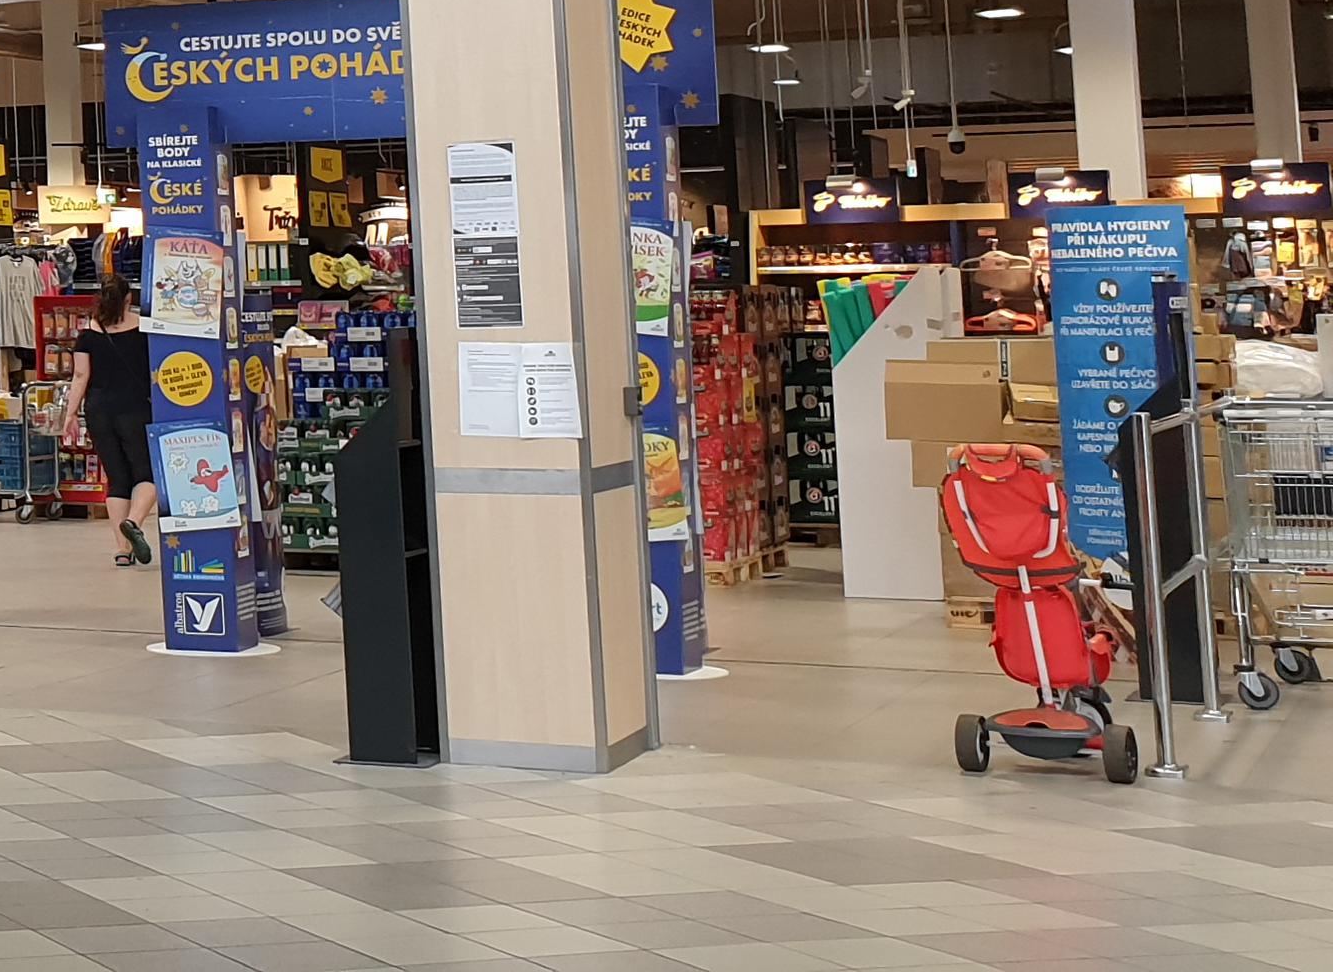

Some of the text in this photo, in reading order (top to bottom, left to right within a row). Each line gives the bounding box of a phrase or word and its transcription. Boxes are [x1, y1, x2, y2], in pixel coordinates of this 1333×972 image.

[621, 8, 651, 23] EDICE
[618, 19, 662, 38] ESKÝCH
[179, 21, 402, 52] CESTUJTE SPOLU DO SVĚ
[618, 31, 655, 48] HÁDEK
[121, 37, 405, 103] ČESKÝCH POHÁD
[148, 133, 198, 147] SBÍREJTE
[625, 140, 651, 151] SICKÉ
[157, 147, 190, 158] BODY
[146, 157, 202, 169] NA KLASICKÉ
[147, 171, 203, 204] ČESKÉ
[152, 204, 204, 215] POHÁDKY
[1107, 220, 1171, 231] HYGIENY
[632, 232, 662, 245] NKA
[1067, 232, 1147, 246] PŘI NÁKUPU
[169, 240, 208, 255] KÁŤA
[1128, 244, 1178, 258] PEČIVA
[1096, 302, 1154, 313] POUŽÍVEJTE
[1060, 315, 1121, 325] EDNORÁZOVÉ
[174, 592, 184, 634] albatros
